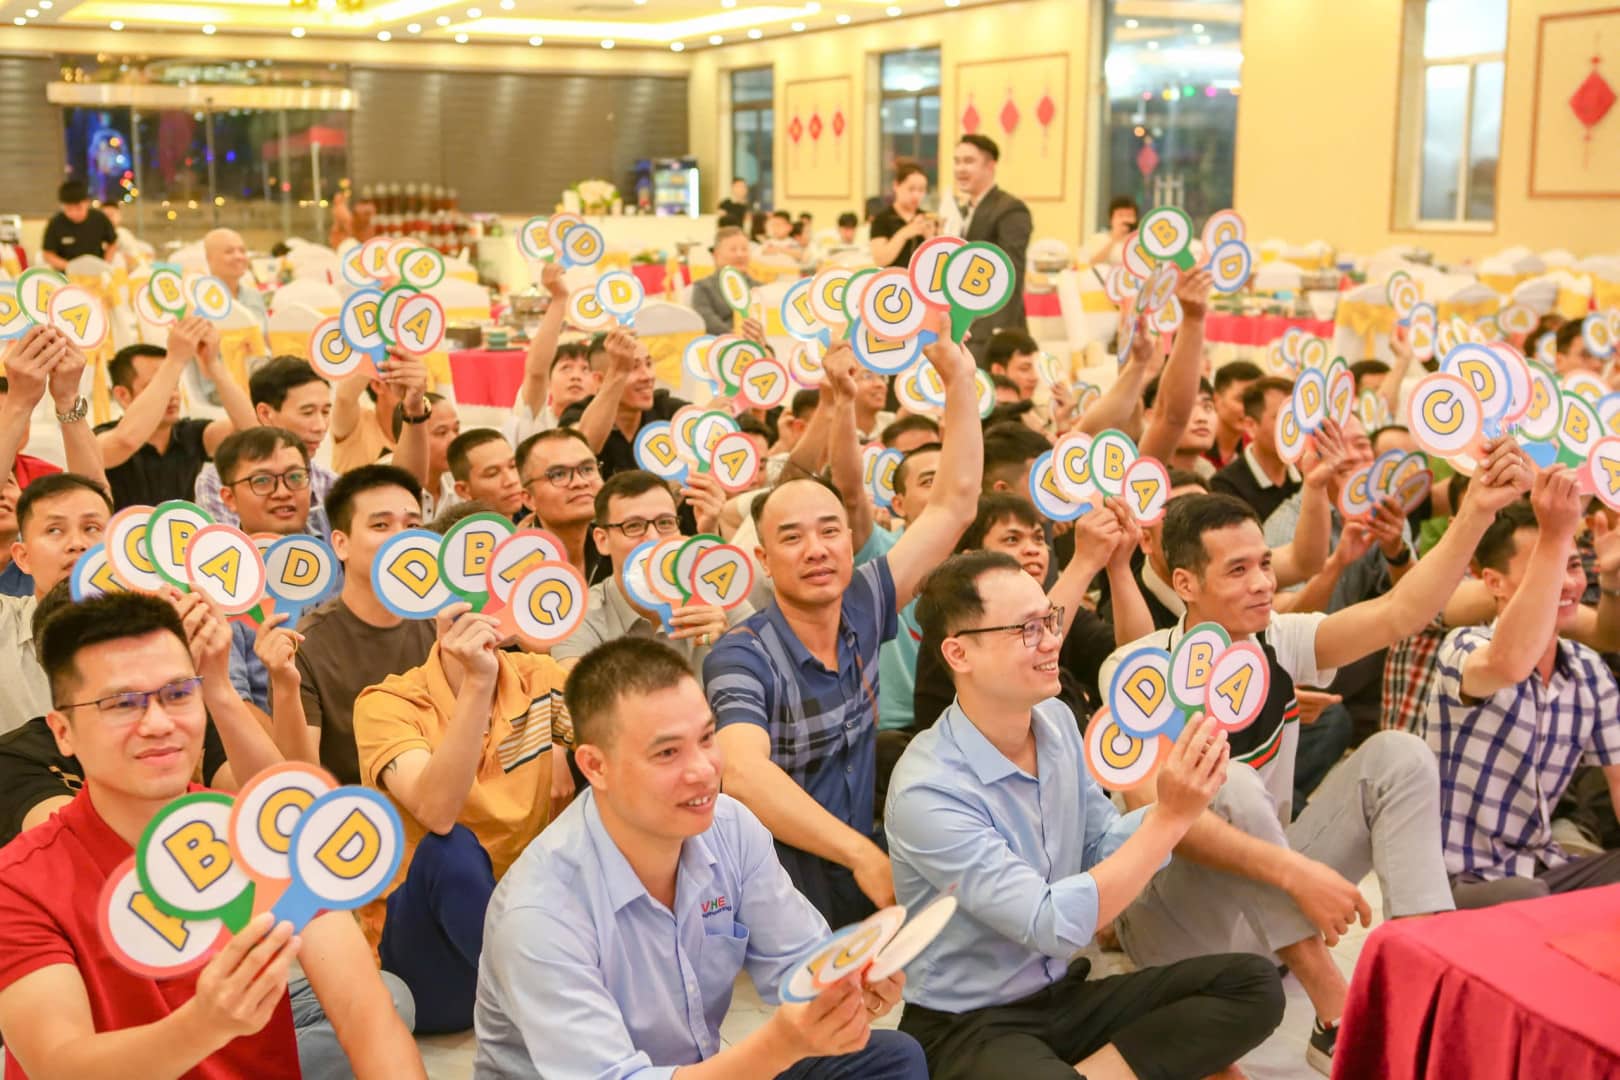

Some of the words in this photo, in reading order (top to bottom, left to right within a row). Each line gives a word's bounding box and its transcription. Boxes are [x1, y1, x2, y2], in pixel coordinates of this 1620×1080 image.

[572, 231, 597, 257] D
[1151, 218, 1178, 248] B
[410, 254, 435, 279] B
[959, 255, 996, 297] B
[1220, 254, 1243, 280] D
[158, 278, 179, 302] B
[203, 284, 225, 310] D
[577, 294, 604, 319] C
[608, 280, 632, 305] D
[873, 284, 913, 324] C
[58, 303, 91, 339] A
[353, 301, 379, 338] D
[402, 308, 432, 345] A
[320, 329, 353, 365] C
[748, 372, 778, 400] A
[1458, 360, 1496, 401] D
[1301, 381, 1321, 418] D
[1422, 389, 1465, 435] C
[1281, 411, 1300, 448] C
[1563, 402, 1590, 443] B
[645, 433, 678, 467] D
[719, 449, 748, 480] A
[1064, 446, 1091, 485] C
[1104, 443, 1125, 480] B
[1131, 479, 1160, 514] A
[168, 519, 199, 567] B
[463, 531, 496, 577] B
[199, 546, 241, 598] A
[281, 547, 321, 587] D
[387, 547, 440, 599] D
[701, 560, 738, 600] A
[528, 578, 573, 625] C
[1185, 641, 1214, 690] B
[1122, 665, 1167, 719] D
[1215, 663, 1254, 715] A
[1101, 722, 1144, 770] C
[162, 820, 234, 893] B
[314, 807, 383, 881] D
[701, 896, 727, 912] VHE
